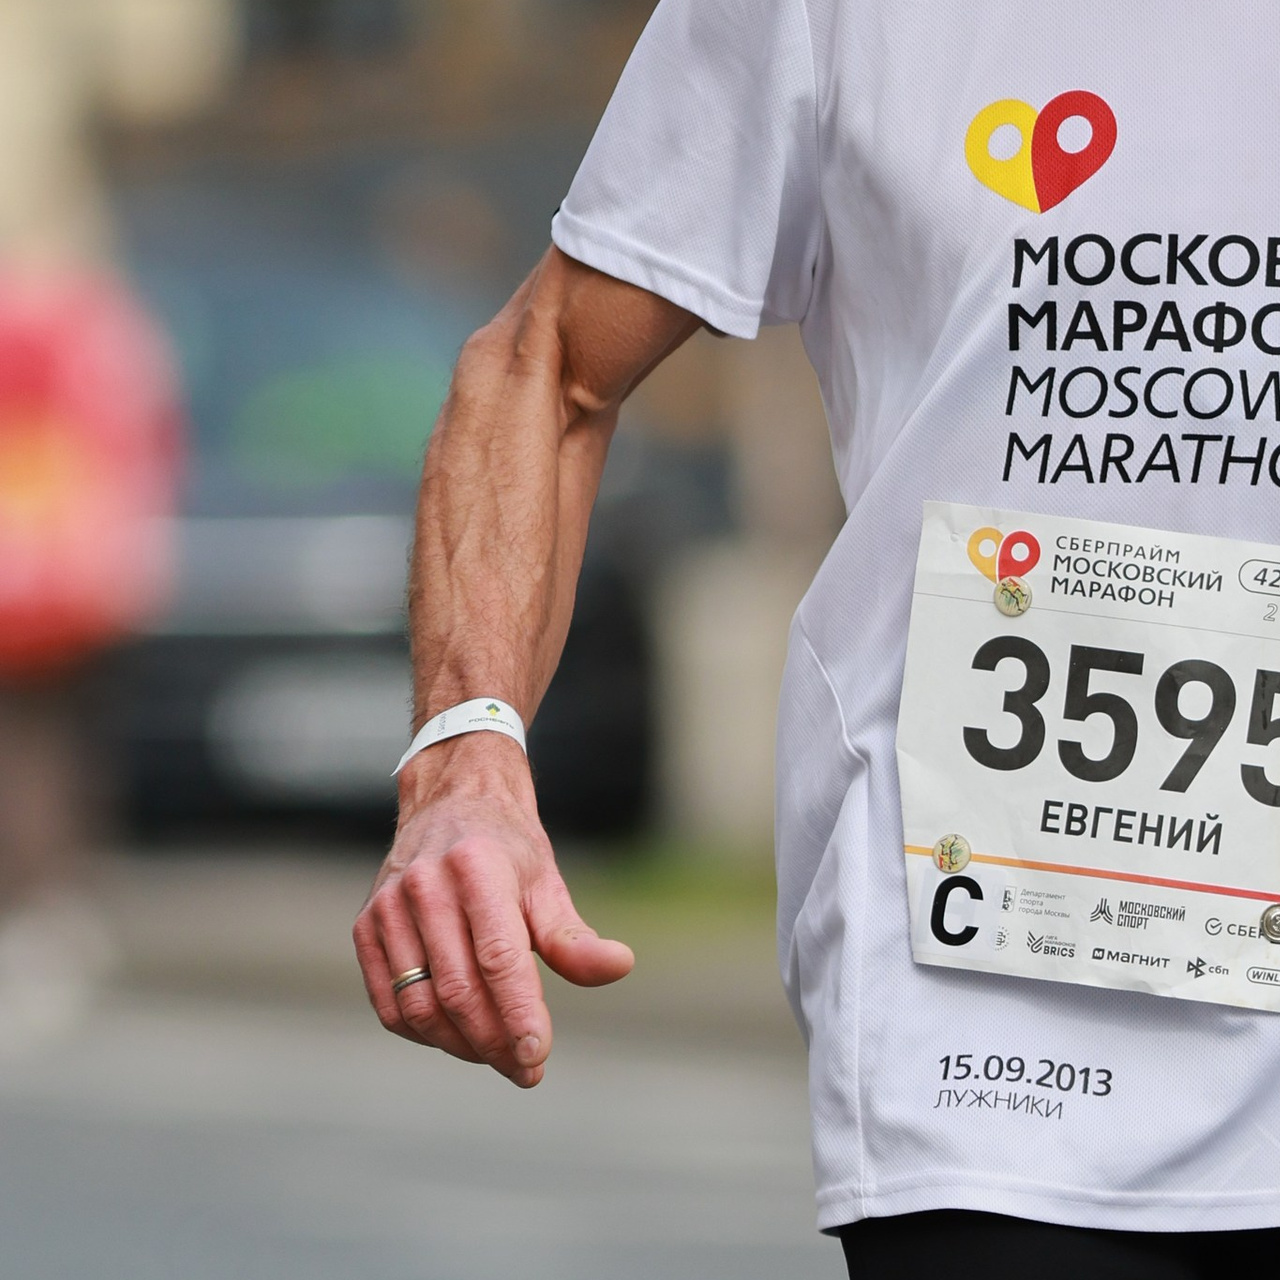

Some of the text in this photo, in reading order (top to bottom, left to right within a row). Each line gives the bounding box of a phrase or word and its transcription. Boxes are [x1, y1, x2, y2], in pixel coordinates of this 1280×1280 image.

[1055, 535, 1181, 564] СБЕРПРАЙМ
[1053, 554, 1223, 592] МОСКОВСКИЙ
[1051, 576, 1175, 608] МАРАФОН
[1039, 799, 1223, 856] ЕВГЕНИЙ
[1019, 897, 1044, 907] спорта
[1020, 888, 1066, 901] Департамент
[1018, 906, 1070, 919] города Москвы
[1118, 900, 1186, 921] МОСКОВСКИЙ
[1117, 914, 1149, 930] СПОРТ
[1043, 945, 1075, 958] BRICS
[1208, 965, 1229, 975] сбп
[939, 1054, 1113, 1097] 15.09.2013
[933, 1089, 1063, 1120] ЛУЖНИКИ
